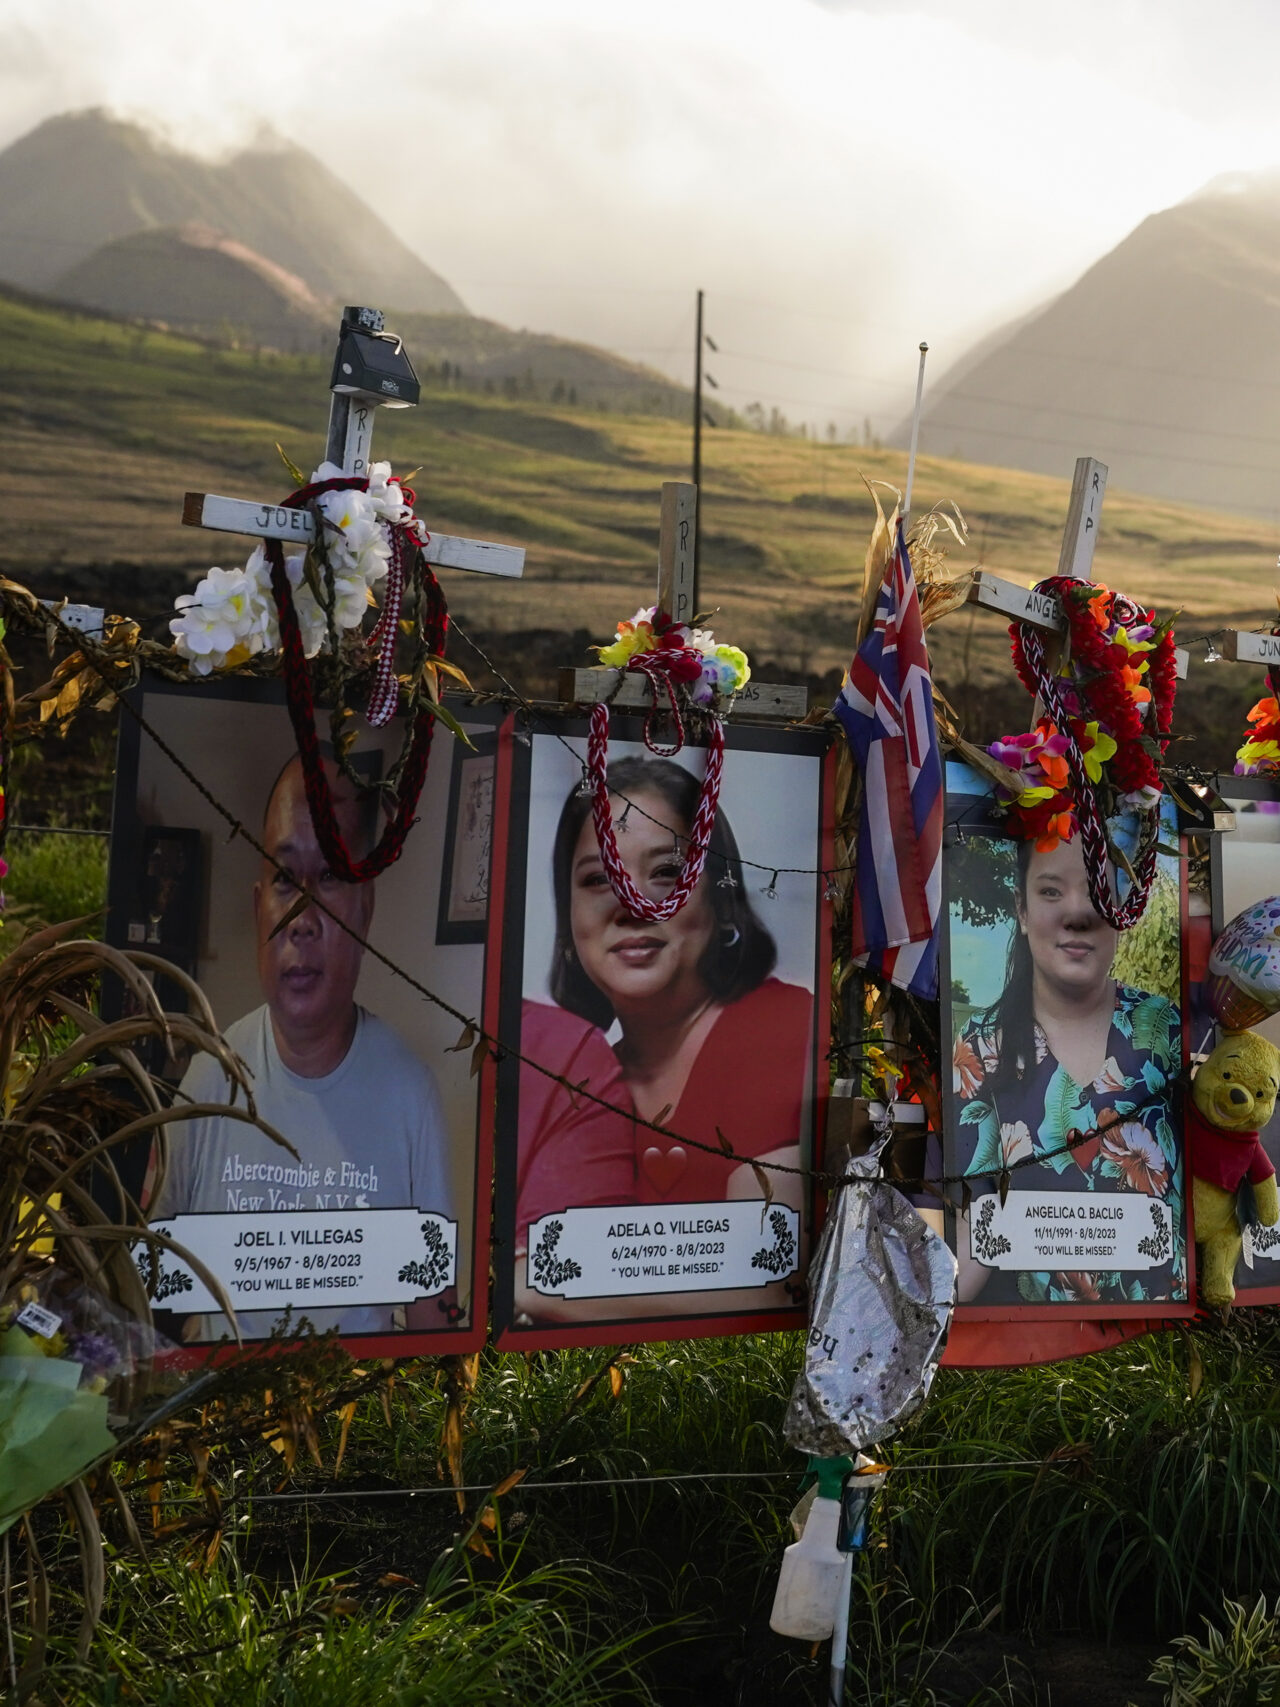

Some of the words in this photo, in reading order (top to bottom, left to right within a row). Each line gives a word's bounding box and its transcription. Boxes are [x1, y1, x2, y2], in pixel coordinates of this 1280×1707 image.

[256, 505, 312, 531] JOEL
[221, 1156, 321, 1188] Abercrombie
[324, 1166, 336, 1186] &
[339, 1161, 379, 1192] Fitch
[1025, 1206, 1075, 1219] ANGELICA
[1090, 1207, 1124, 1220] BACLIG
[607, 1223, 650, 1238] ADELA
[669, 1218, 730, 1234] VILLEGAS
[1034, 1226, 1073, 1239] 11/11/1991
[1079, 1226, 1116, 1239] 8/8/2023
[233, 1231, 274, 1248] JOEL
[278, 1231, 287, 1246] I.
[290, 1229, 364, 1245] VILLEGAS
[611, 1246, 667, 1260] 6/24/1970
[676, 1242, 725, 1256] 8/8/2023
[1034, 1245, 1054, 1255] "YOU
[1055, 1246, 1073, 1255] WILL
[1075, 1246, 1084, 1255] BE
[1085, 1245, 1117, 1256] MISSED."
[234, 1256, 291, 1272] 9/5/1967
[302, 1254, 361, 1269] 8/8/2023
[618, 1266, 640, 1278] YOU
[642, 1265, 666, 1277] WILL
[668, 1264, 680, 1276] BE
[683, 1262, 724, 1274] MISSED."
[231, 1279, 261, 1292] "YOU
[264, 1278, 292, 1291] WILL
[296, 1278, 311, 1289] BE
[313, 1275, 364, 1288] MISSED."
